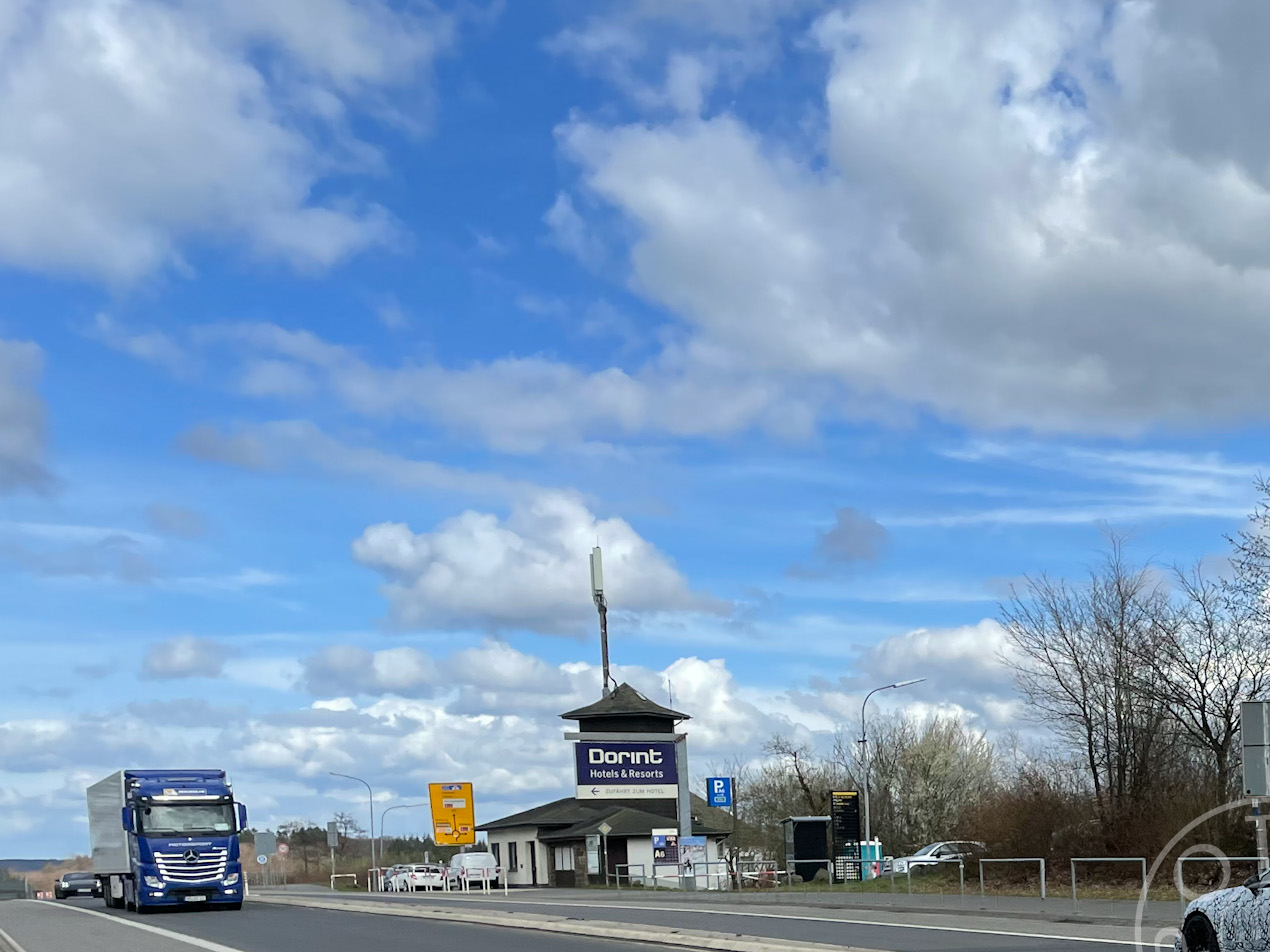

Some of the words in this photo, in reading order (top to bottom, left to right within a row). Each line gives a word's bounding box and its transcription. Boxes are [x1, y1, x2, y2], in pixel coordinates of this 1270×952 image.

[588, 748, 663, 765] Dorint
[590, 769, 619, 779] Hotels
[620, 769, 628, 778] &
[629, 769, 664, 778] Resorts
[713, 780, 724, 794] P
